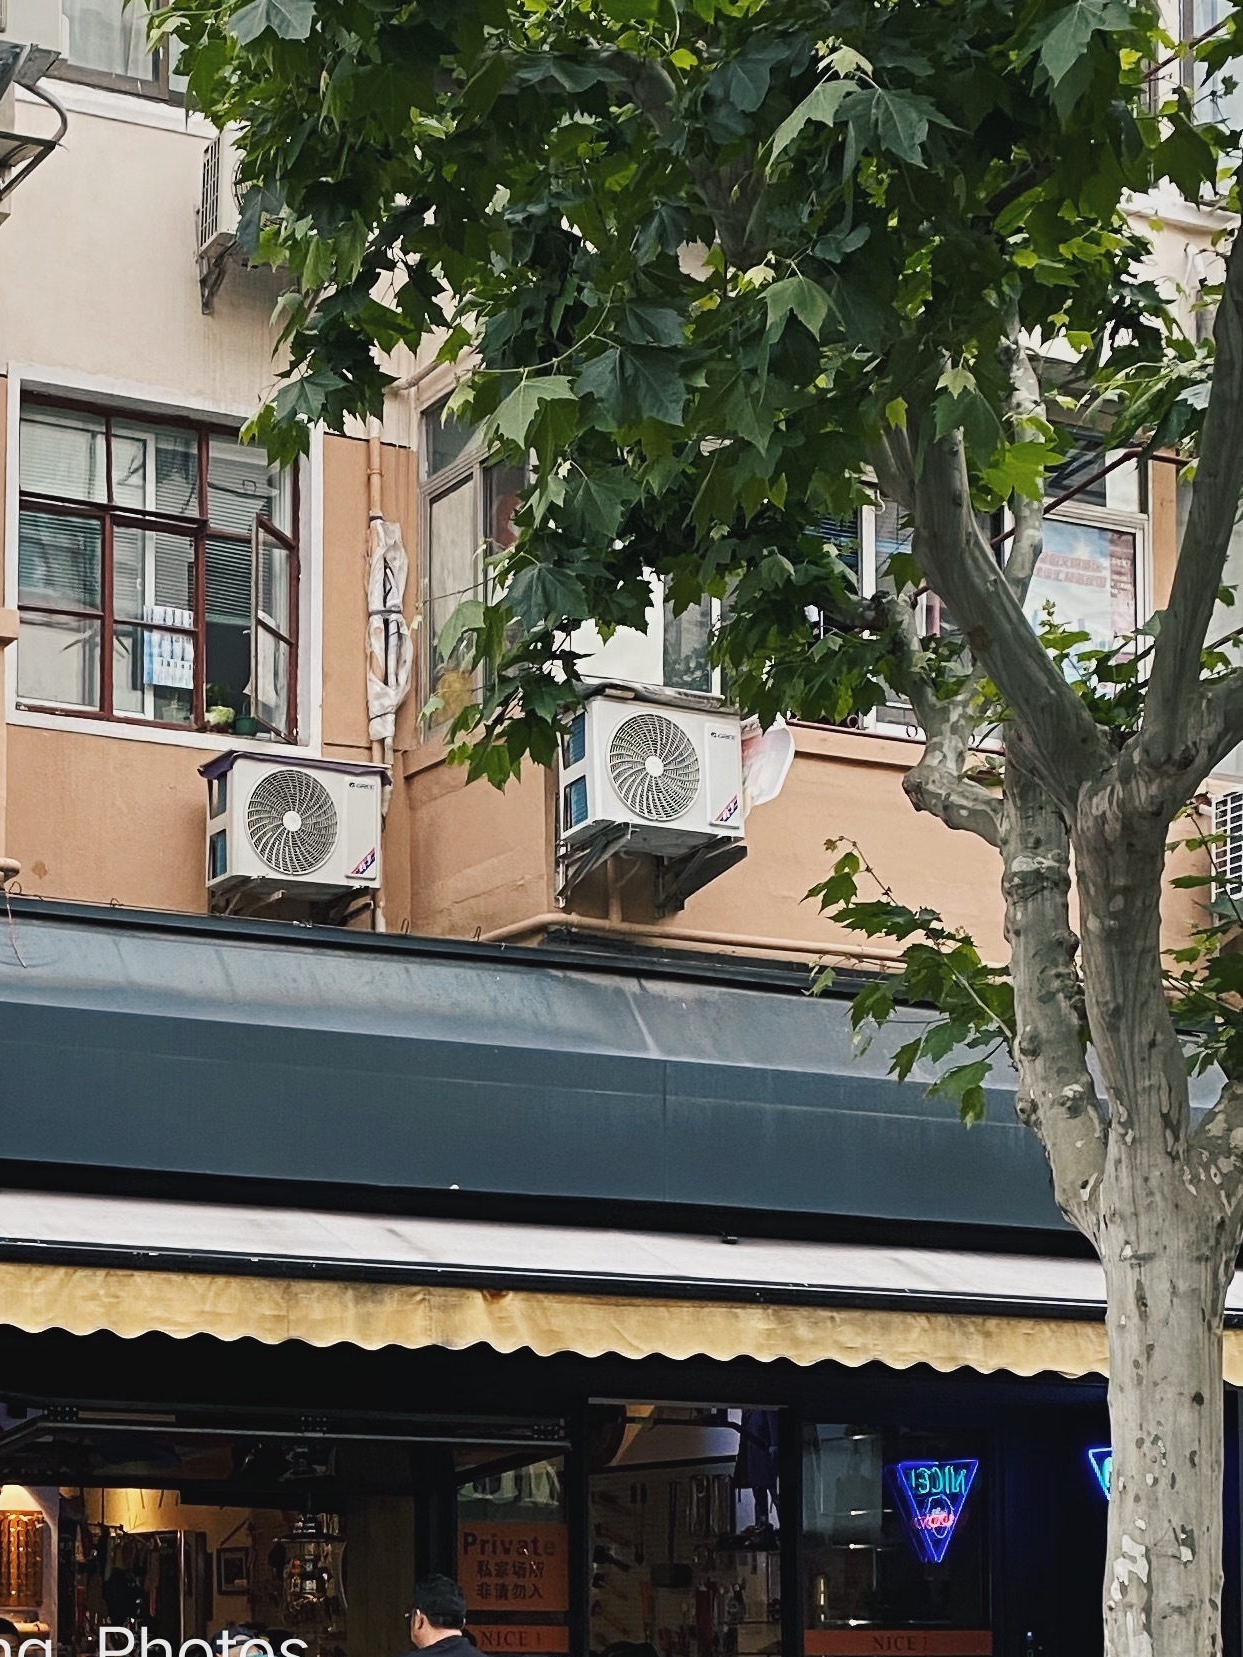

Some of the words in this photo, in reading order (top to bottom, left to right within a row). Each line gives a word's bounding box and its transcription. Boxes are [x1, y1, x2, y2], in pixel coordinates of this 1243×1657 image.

[463, 1532, 556, 1556] Private
[476, 1581, 544, 1600] 非请勿入
